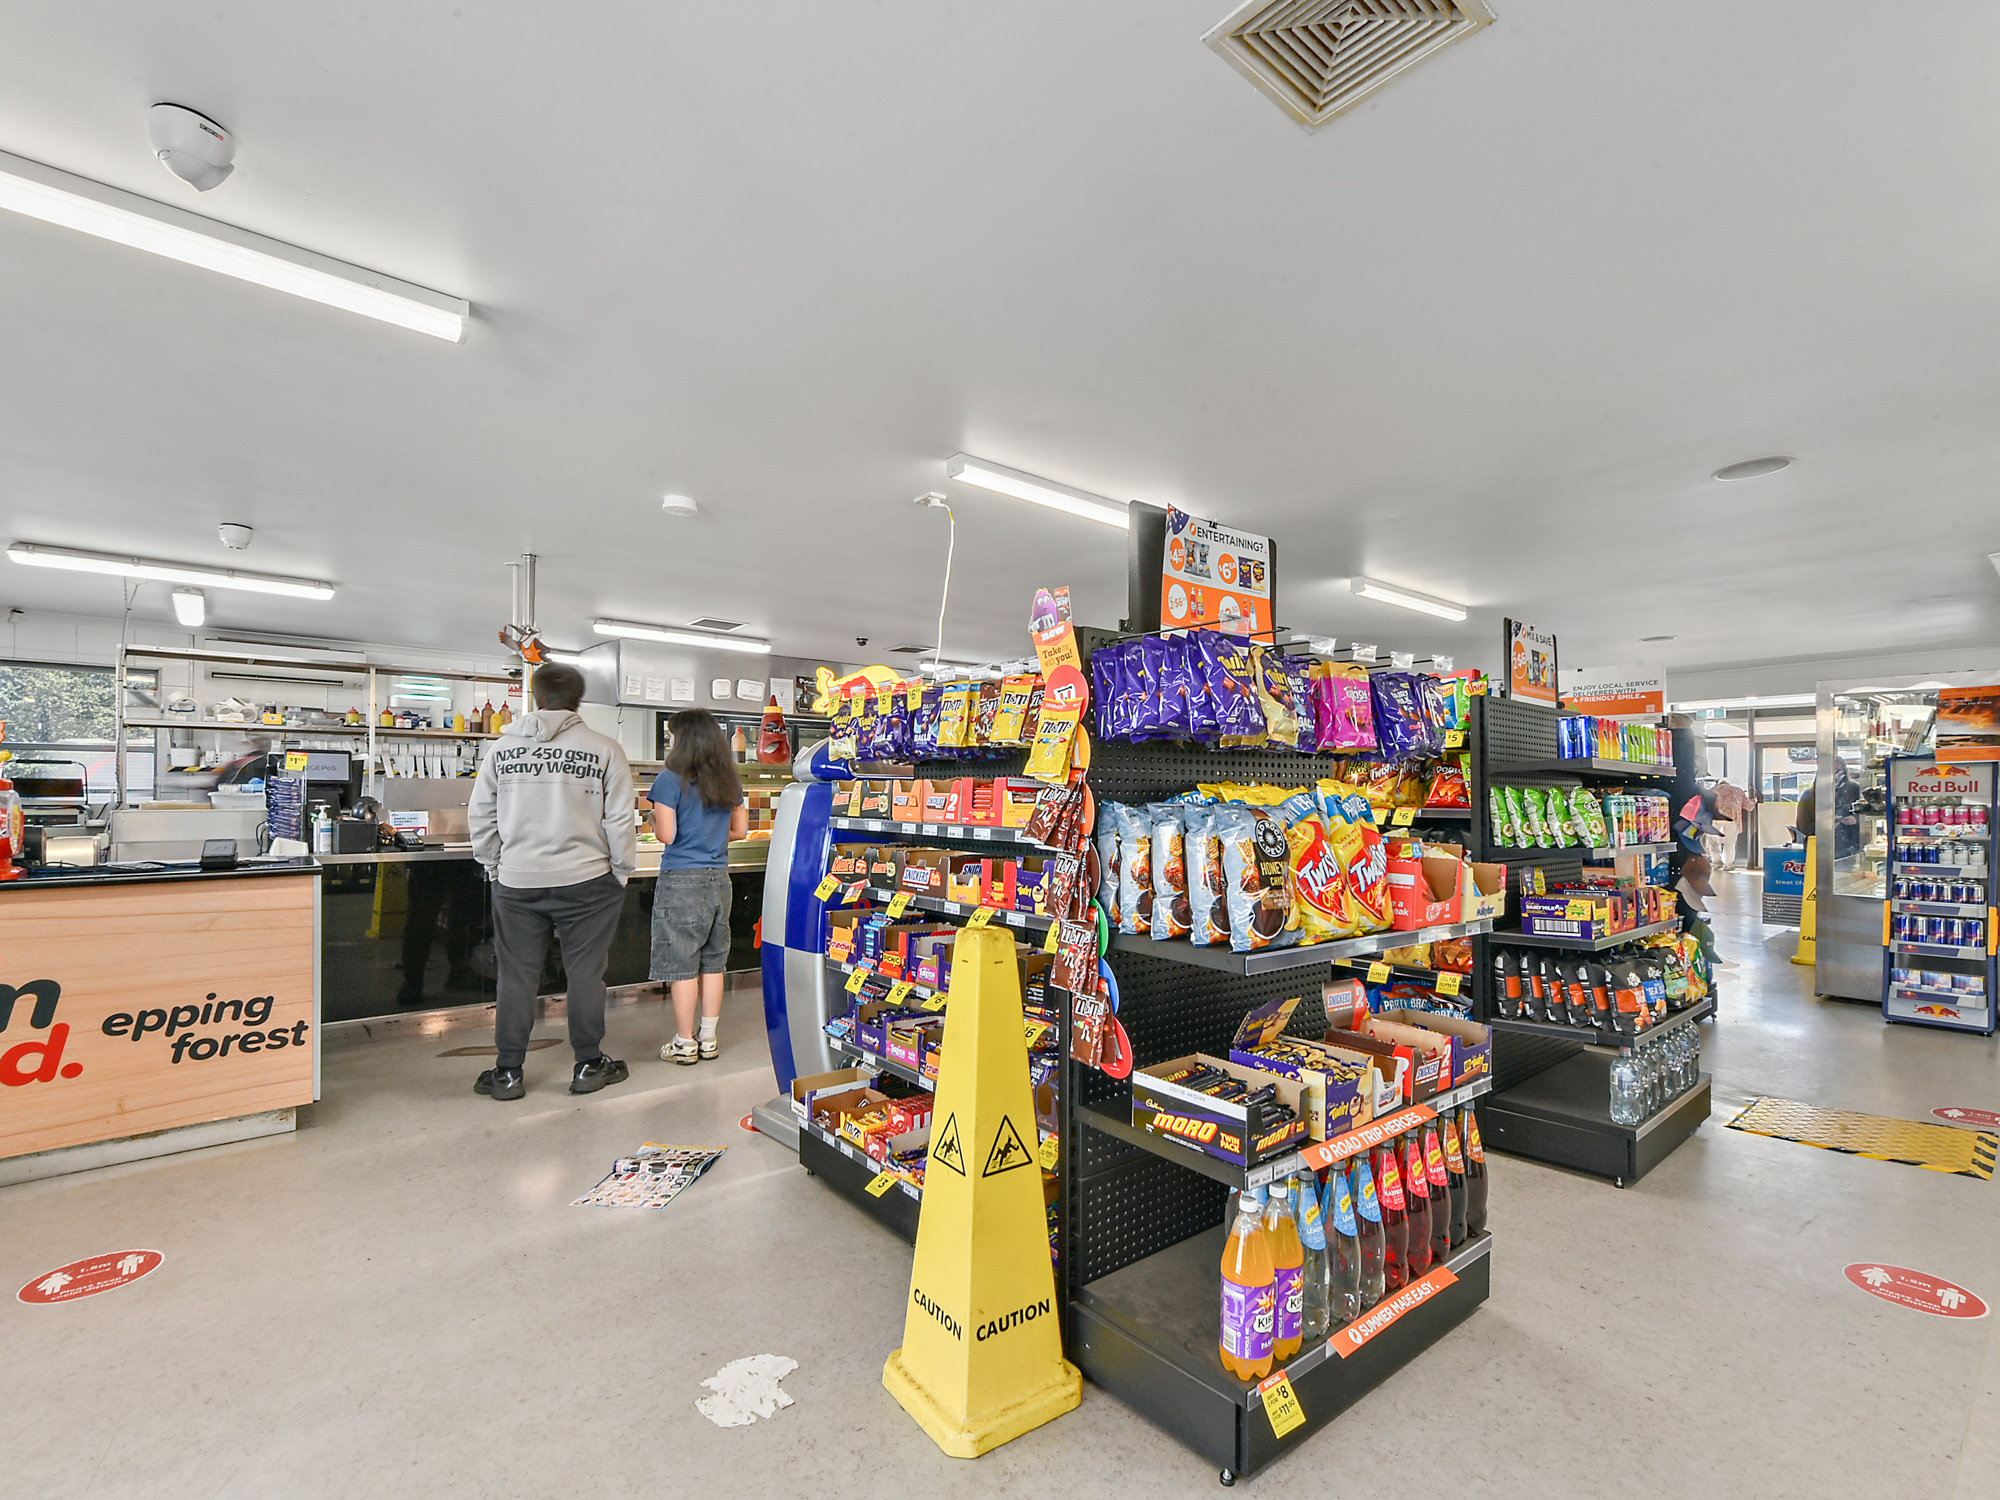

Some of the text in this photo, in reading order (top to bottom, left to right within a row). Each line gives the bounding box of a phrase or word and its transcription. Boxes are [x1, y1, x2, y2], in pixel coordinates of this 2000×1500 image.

[1197, 526, 1264, 553] ENTERTAINING?
[1041, 625, 1065, 641] new
[1042, 646, 1062, 659] Take
[1055, 649, 1073, 666] you!
[1572, 679, 1659, 692] ENJOY LOCAL SERVICE
[1572, 687, 1637, 698] DELIVERED WITH
[1579, 695, 1615, 704] FRIENDLY
[1617, 693, 1641, 701] SMILE
[1448, 733, 1458, 742] $5
[532, 747, 563, 760] 450
[565, 749, 600, 765] gsm
[497, 761, 604, 780] Heavy Weight
[1908, 780, 1979, 793] Red Bull
[947, 792, 958, 812] 2
[1399, 811, 1409, 821] $6
[1257, 824, 1266, 843] RED
[1265, 821, 1285, 842] ROCK
[1264, 845, 1284, 856] DELI
[831, 856, 856, 874] Mars
[1260, 860, 1285, 876] HONEY
[903, 868, 931, 885] SNICKERS
[883, 952, 902, 966] PICNIC
[1327, 991, 1353, 1008] SNICKERS
[1355, 985, 1365, 1009] 2
[1383, 997, 1428, 1011] PARTY BAG
[101, 992, 275, 1042] epping
[171, 1020, 309, 1064] forest
[1442, 1043, 1452, 1068] 2
[926, 1063, 940, 1075] crun
[1416, 1060, 1441, 1080] SNICKERS
[1145, 1098, 1165, 1113] Cadbury
[1152, 1111, 1219, 1143] MORO
[1219, 1131, 1241, 1145] TWIN
[1219, 1139, 1241, 1154] PACK
[1255, 1123, 1291, 1153] MORO
[1329, 1136, 1361, 1158] ROAD
[1358, 1126, 1384, 1147] TRIP
[878, 1176, 889, 1189] $3
[1870, 1288, 1948, 1314] social distance
[1879, 1287, 1941, 1308] Please keep
[913, 1288, 962, 1341] CAUTION
[976, 1297, 1050, 1342] CAUTION
[1257, 1314, 1272, 1328] KIR
[1358, 1307, 1395, 1338] SUMMER
[1391, 1293, 1418, 1316] MADE
[1263, 1374, 1282, 1389] SPECIAL
[1276, 1385, 1289, 1399] $8
